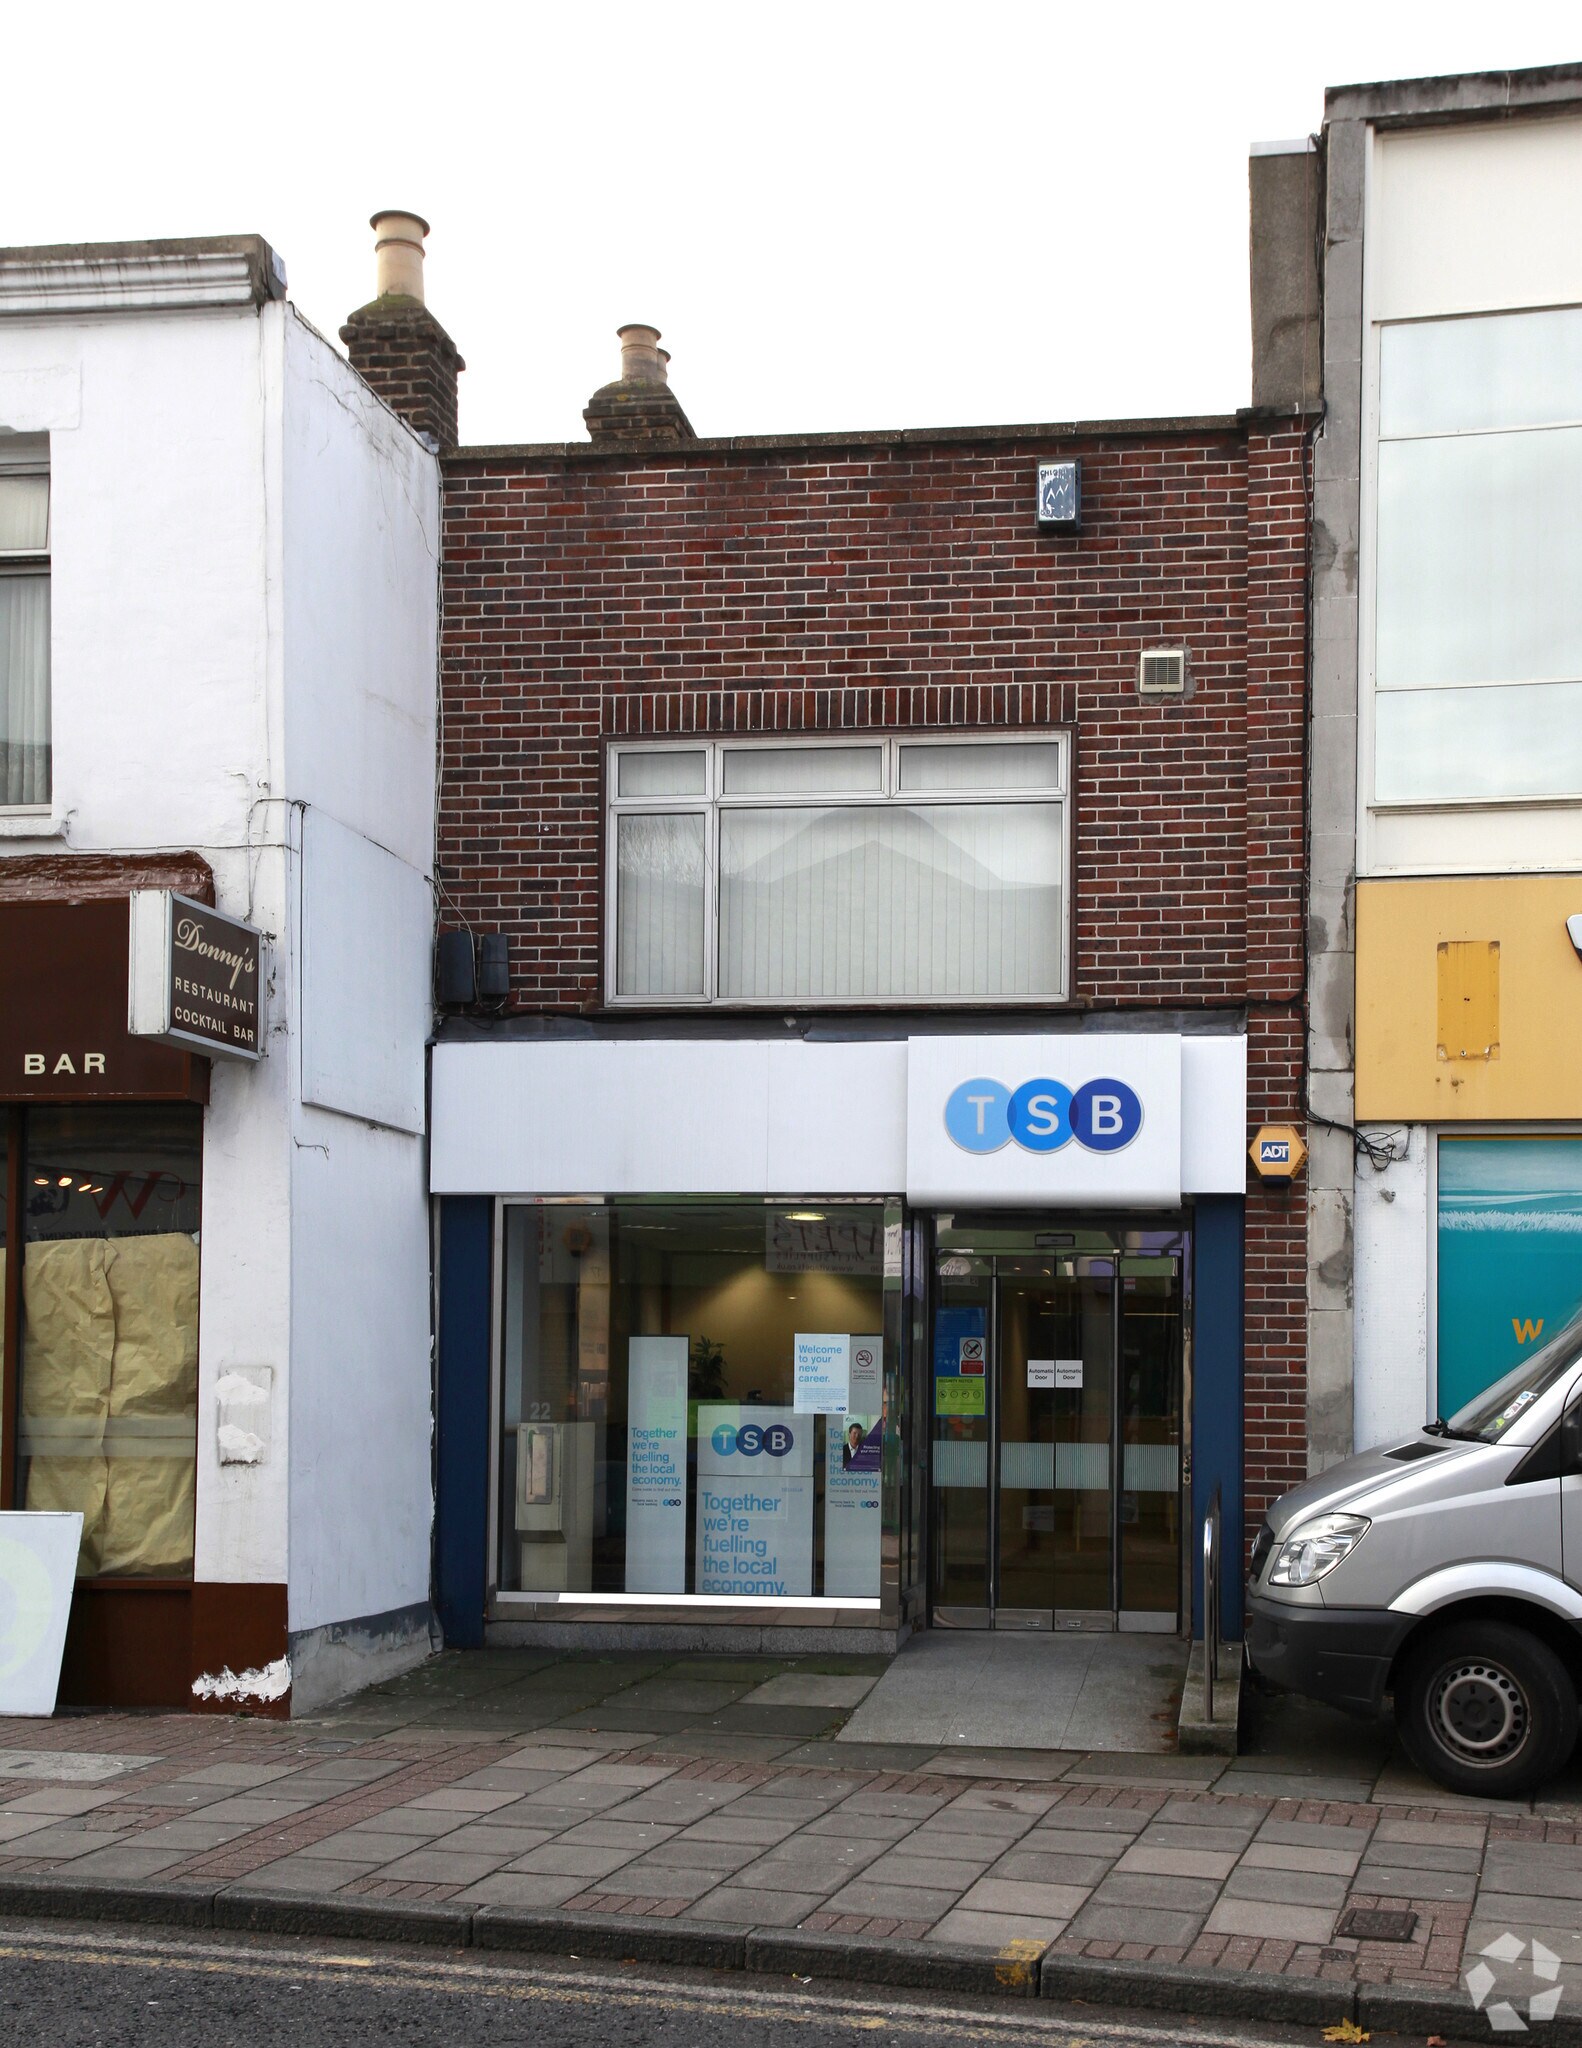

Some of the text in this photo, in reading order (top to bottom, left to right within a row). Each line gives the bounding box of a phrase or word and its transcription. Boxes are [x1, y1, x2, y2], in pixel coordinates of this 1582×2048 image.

[175, 918, 255, 989] Donny's
[175, 976, 254, 1014] RESTAURANT
[174, 1006, 254, 1042] COCKTAIL BAR
[24, 1053, 106, 1075] BAR
[966, 1095, 1124, 1135] TSB
[1261, 1144, 1289, 1159] ADT
[798, 1344, 842, 1354] Welcome
[799, 1354, 832, 1365] to your
[798, 1374, 831, 1383] career.
[529, 1401, 551, 1420] 22
[631, 1427, 677, 1440] Together
[719, 1431, 786, 1450] TSB
[632, 1439, 660, 1450] we're
[632, 1451, 670, 1463] fuelling
[631, 1463, 675, 1474] the local
[631, 1475, 682, 1487] economy.
[829, 1477, 879, 1488] economy.
[702, 1492, 782, 1514] Together
[703, 1514, 749, 1532] we're
[703, 1534, 767, 1557] fuelling
[703, 1556, 777, 1575] the local
[702, 1578, 788, 1596] economy.
